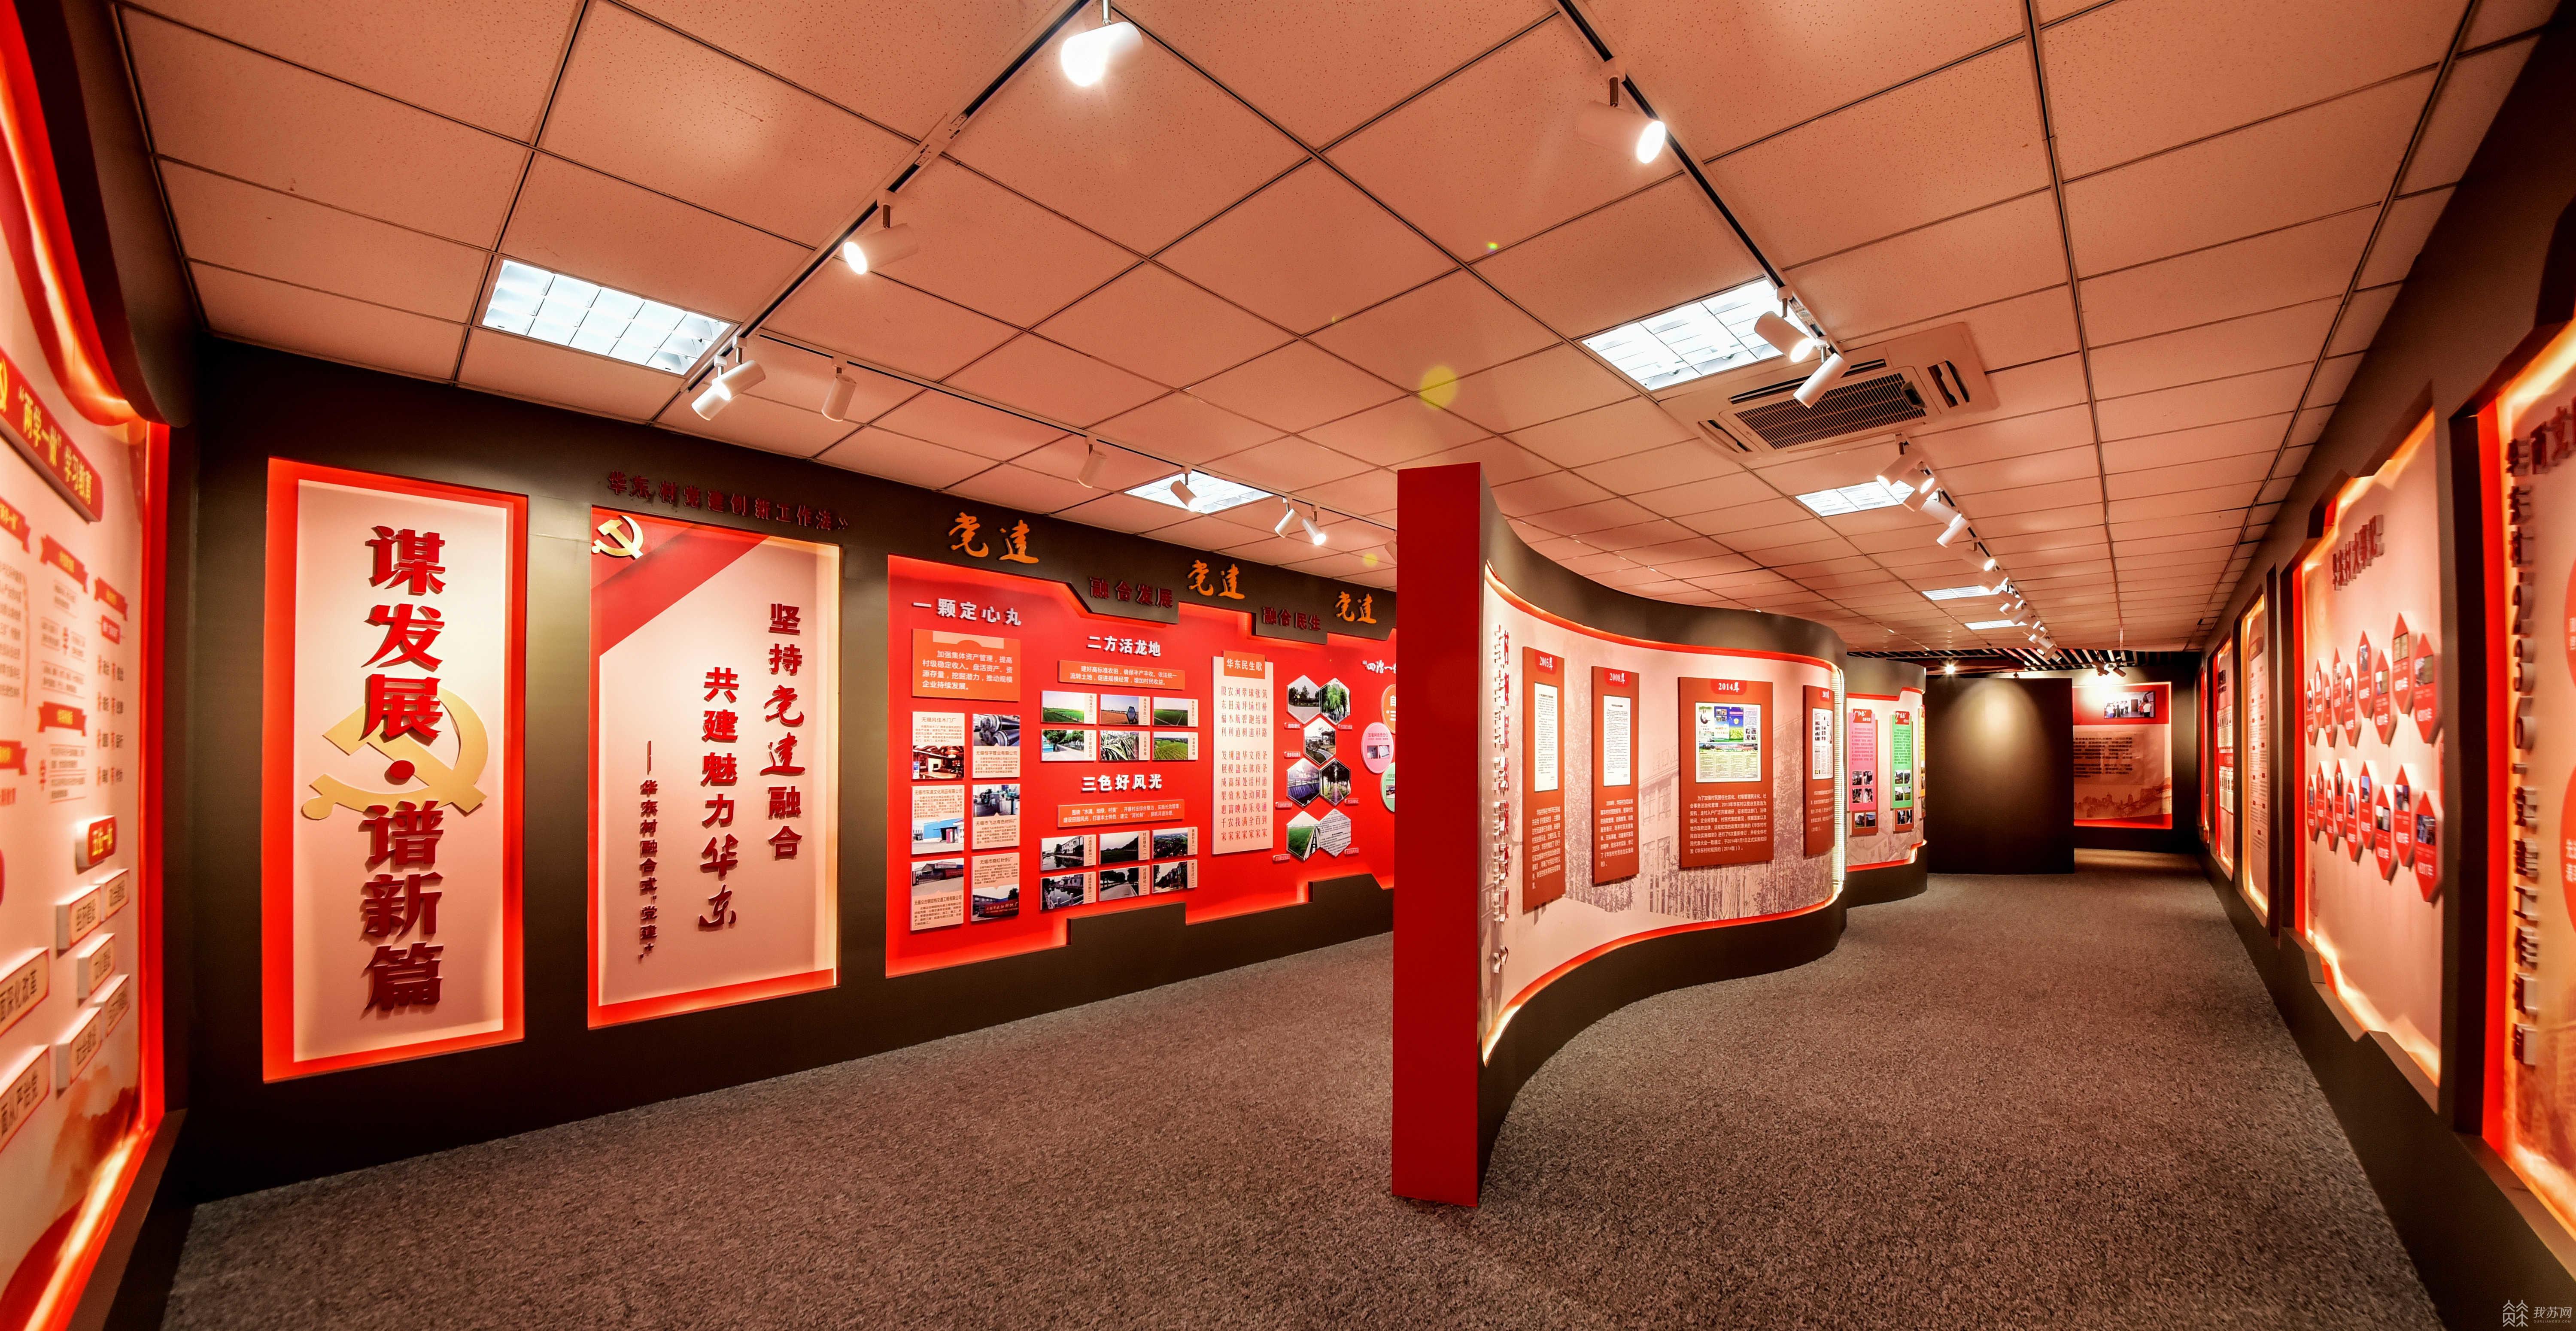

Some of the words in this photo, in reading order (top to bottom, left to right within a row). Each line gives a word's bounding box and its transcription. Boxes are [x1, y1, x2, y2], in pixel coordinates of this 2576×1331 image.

[948, 512, 1039, 564] 党建
[1187, 559, 1245, 600] 党建
[1088, 576, 1175, 609] 融合发展
[913, 597, 1022, 626] 一颗定心丸
[1261, 606, 1321, 631] 融合民生
[1334, 591, 1377, 624] 党建
[937, 650, 1013, 664] 加强集体资产管理，提高
[1087, 635, 1161, 657] 二方活龙地
[922, 659, 1013, 673] 村级稳定收入。盘活资产、资
[1226, 658, 1263, 672] 华东民生歌
[1539, 656, 1553, 671] 2005年
[922, 670, 1013, 683] 源存量，挖掘潜力，推动规模
[922, 680, 969, 691] 企业持续发展。
[1609, 672, 1625, 685] 2008年
[1718, 682, 1740, 693] 2014年
[759, 603, 806, 860] 坚持党建融合
[361, 525, 447, 1014] 谋发展·谱新篇
[1081, 774, 1163, 791] 三色好风光
[698, 667, 739, 931] 共建魅力华东
